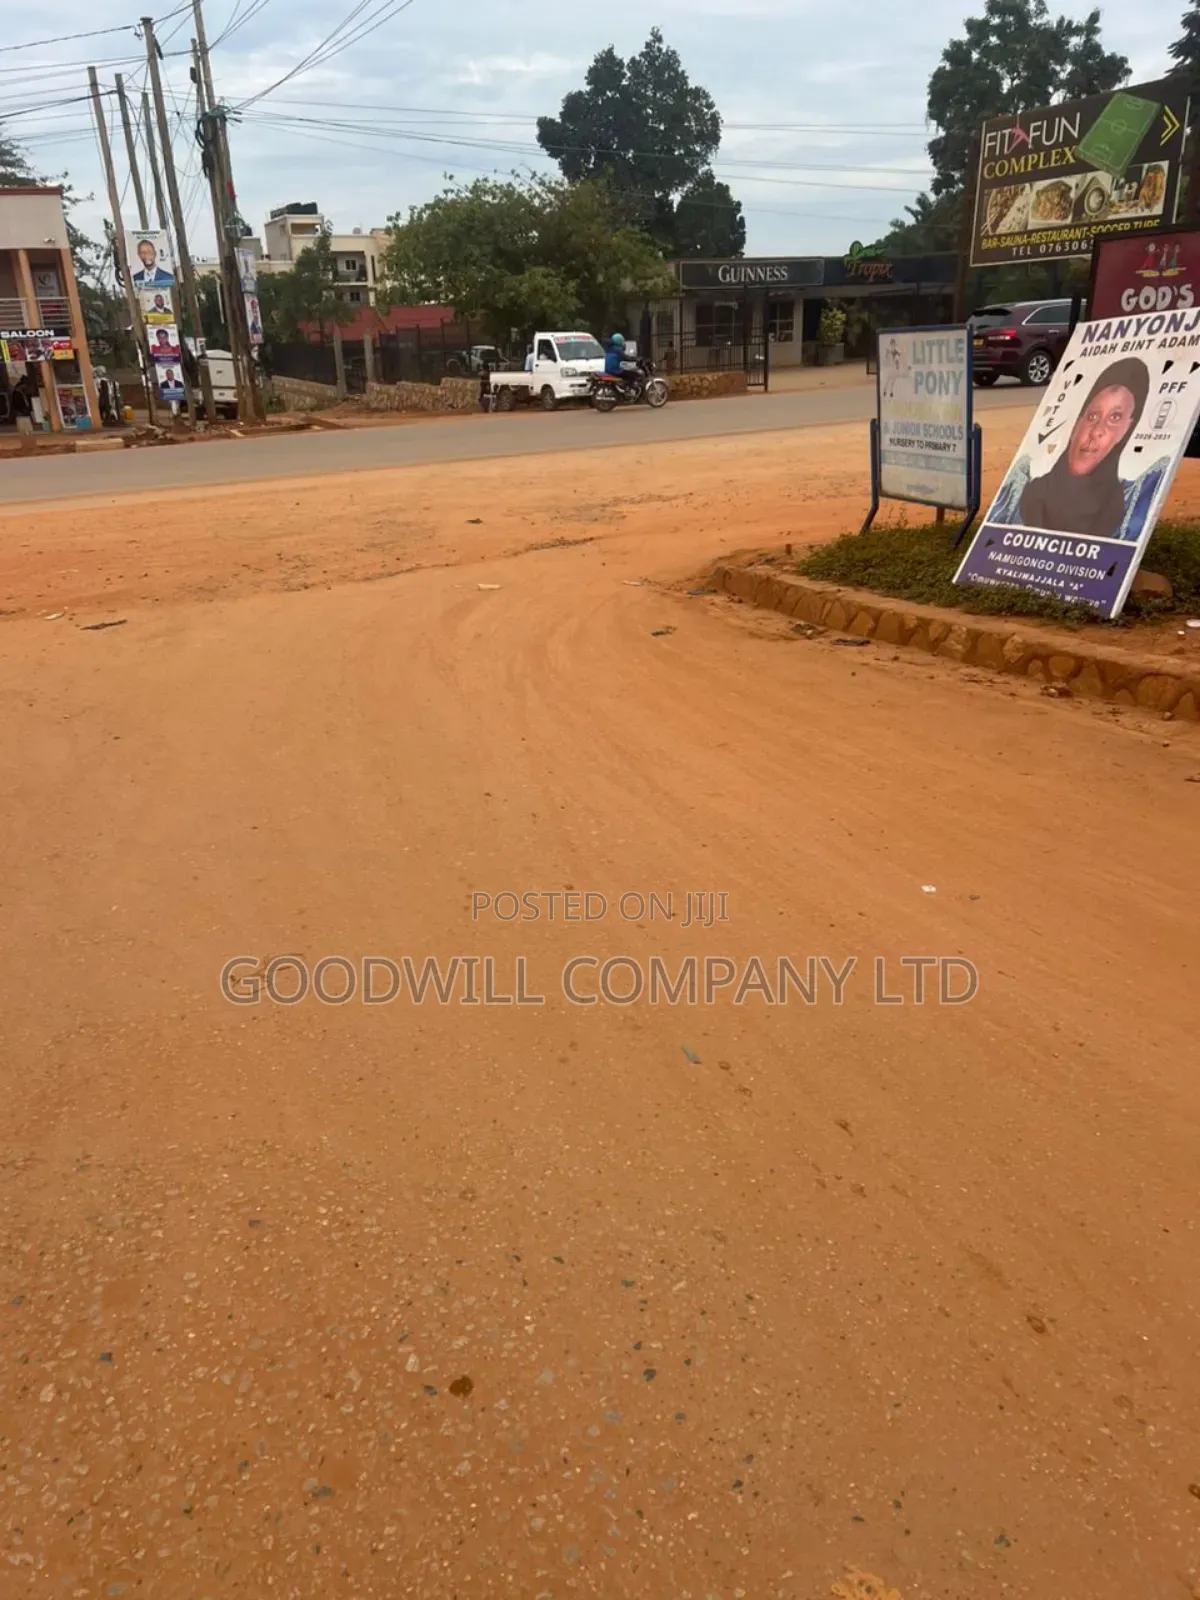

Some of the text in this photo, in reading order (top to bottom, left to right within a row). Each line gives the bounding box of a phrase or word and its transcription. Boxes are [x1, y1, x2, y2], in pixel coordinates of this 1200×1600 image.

[984, 112, 1081, 158] FIT FUN
[983, 145, 1078, 179] COMPLEX
[1012, 246, 1032, 257] TEL
[718, 264, 789, 283] GUINNESS
[1121, 283, 1195, 312] GOD'S
[0, 329, 55, 339] SALOON
[1080, 334, 1200, 358] AIDAH BINT ADAM
[913, 338, 964, 364] LITTLE
[914, 371, 962, 396] PONY
[1158, 381, 1188, 394] PFF
[923, 423, 964, 440] SCHOOLS
[889, 437, 915, 448] NURSERY
[916, 439, 925, 449] TO
[925, 441, 951, 452] PRIMARY
[1002, 532, 1101, 560] COUNCILOR
[987, 551, 1107, 580] NAMUGONGO DIVISION
